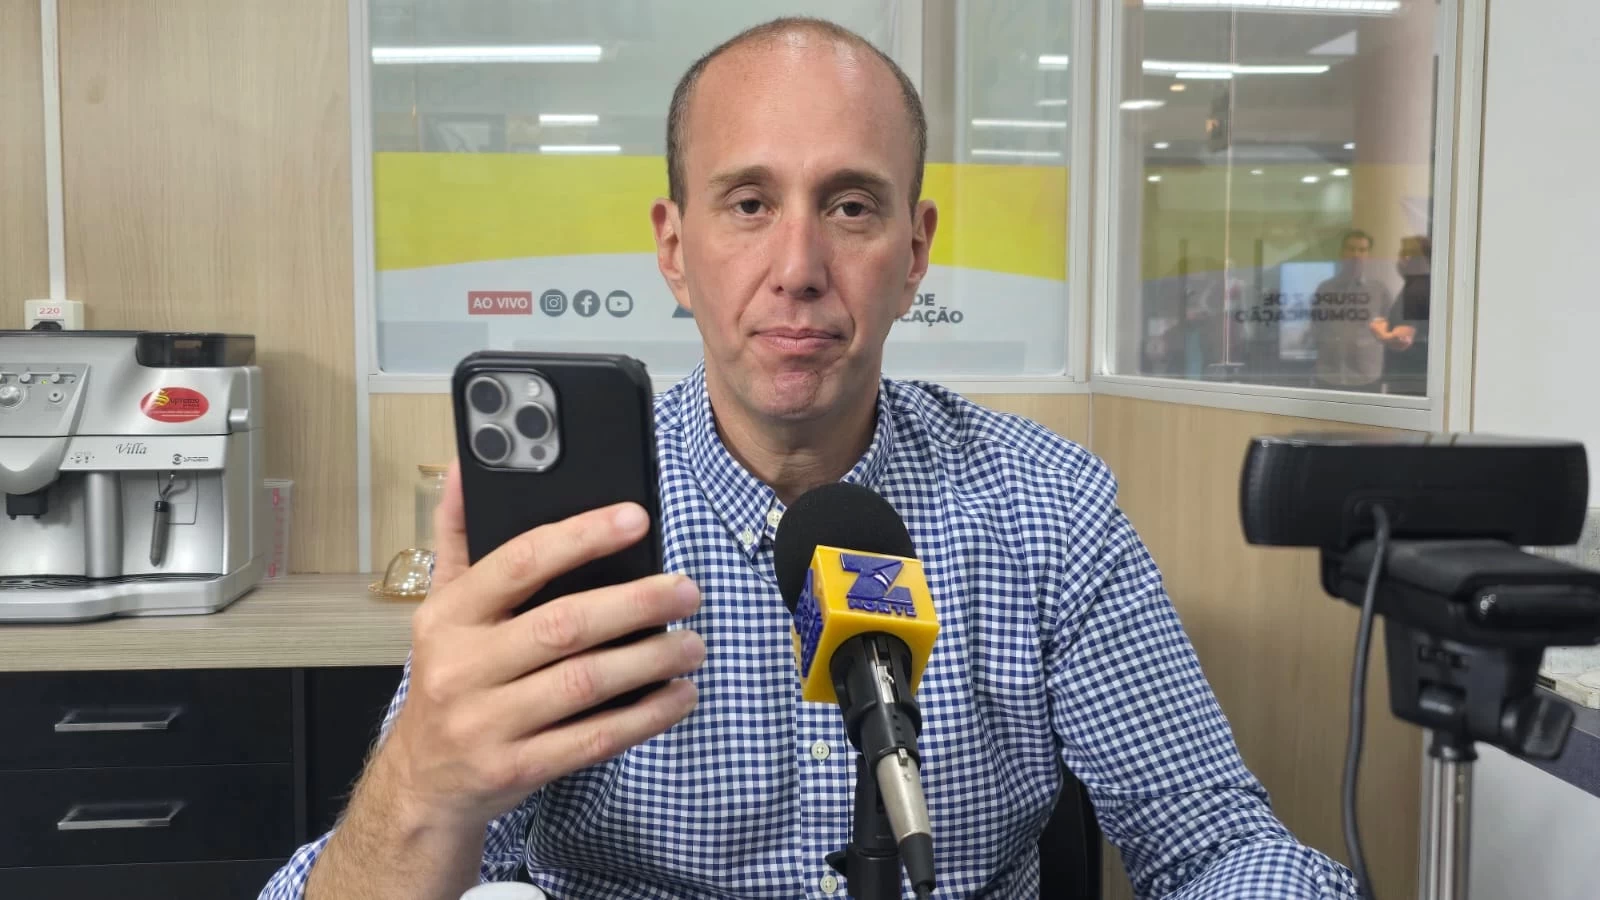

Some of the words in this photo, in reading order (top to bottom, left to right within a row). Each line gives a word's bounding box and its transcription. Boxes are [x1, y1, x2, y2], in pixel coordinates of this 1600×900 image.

[473, 296, 493, 309] AO
[497, 296, 528, 309] VIVO
[39, 306, 60, 315] 220
[895, 306, 964, 326] CAÇÃO
[115, 442, 148, 455] Villa
[847, 599, 918, 618] NORTE
